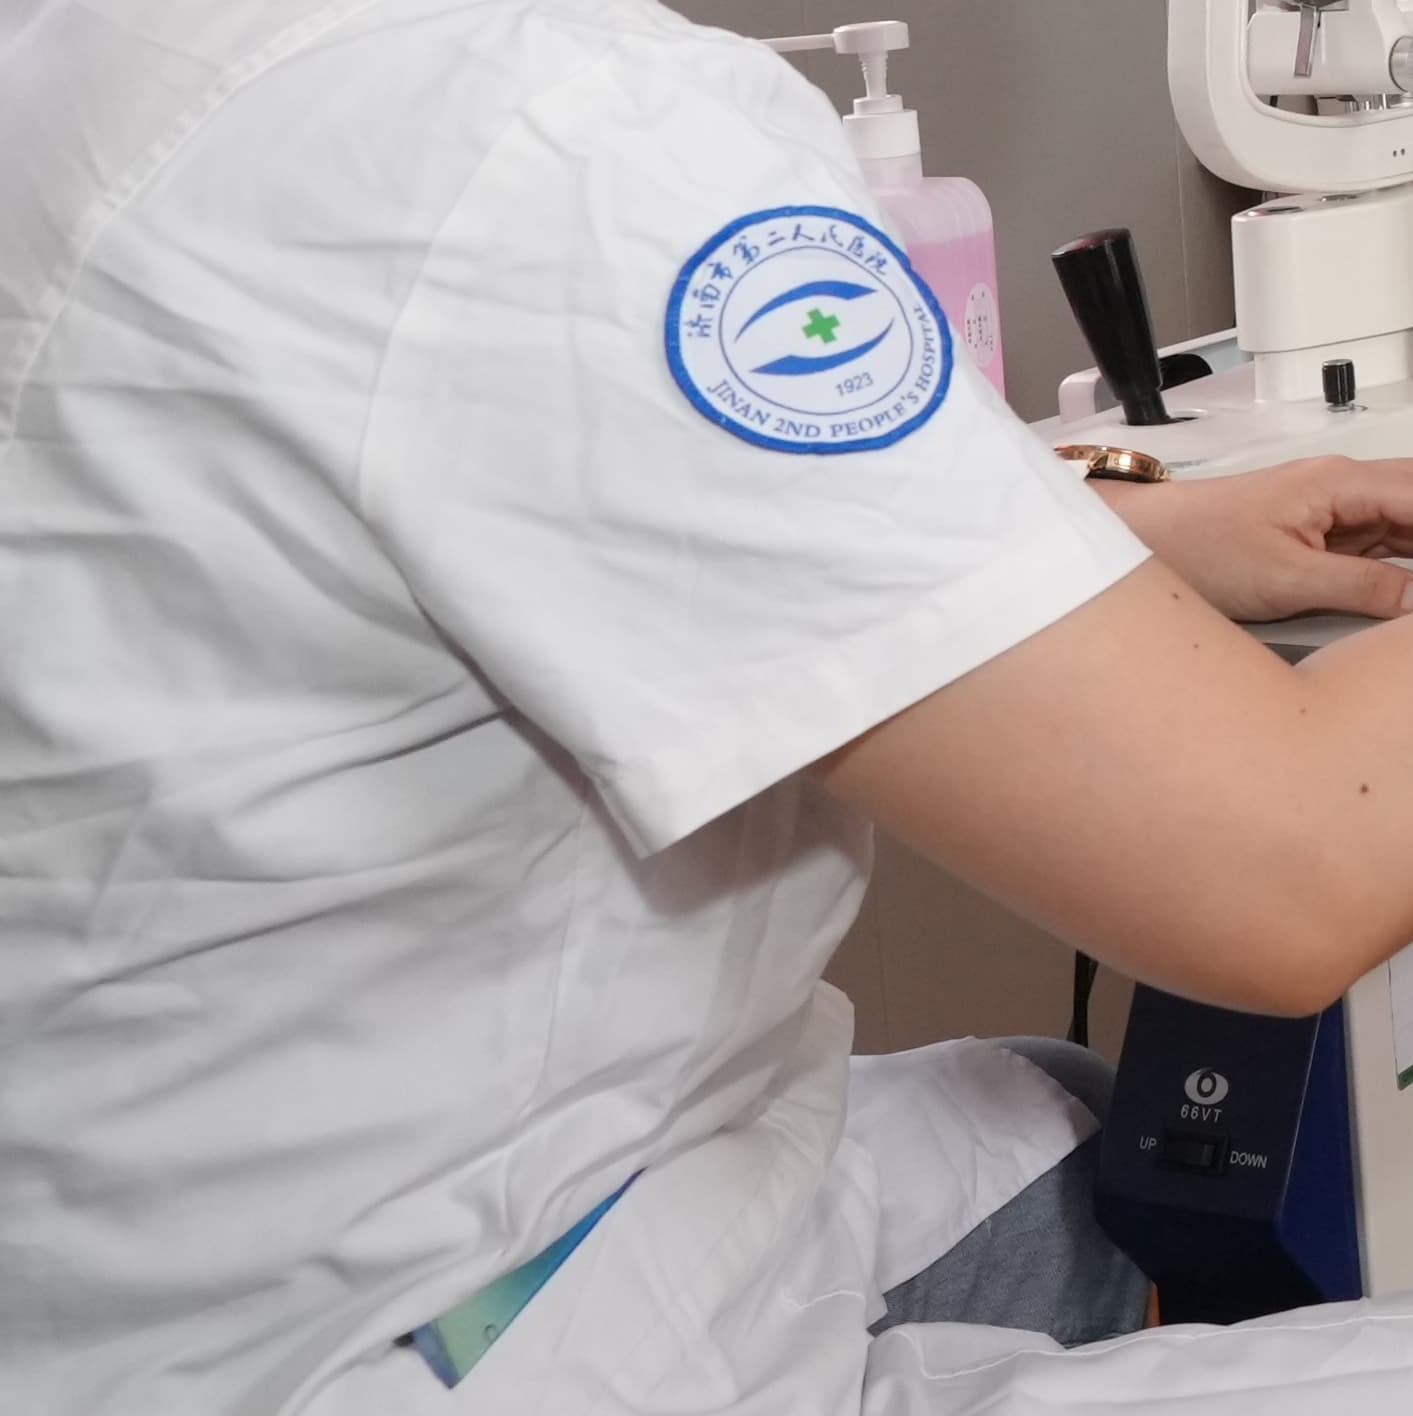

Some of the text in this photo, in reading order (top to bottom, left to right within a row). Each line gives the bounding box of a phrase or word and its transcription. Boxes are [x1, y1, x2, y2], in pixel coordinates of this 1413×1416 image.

[706, 379, 770, 426] JINAN
[773, 418, 822, 438] 2ND
[831, 391, 920, 438] PEOPLE'S
[913, 305, 936, 393] HOSPITAL
[835, 372, 874, 397] 1923
[1139, 1137, 1158, 1150] UP
[1229, 1150, 1268, 1169] DOWN
